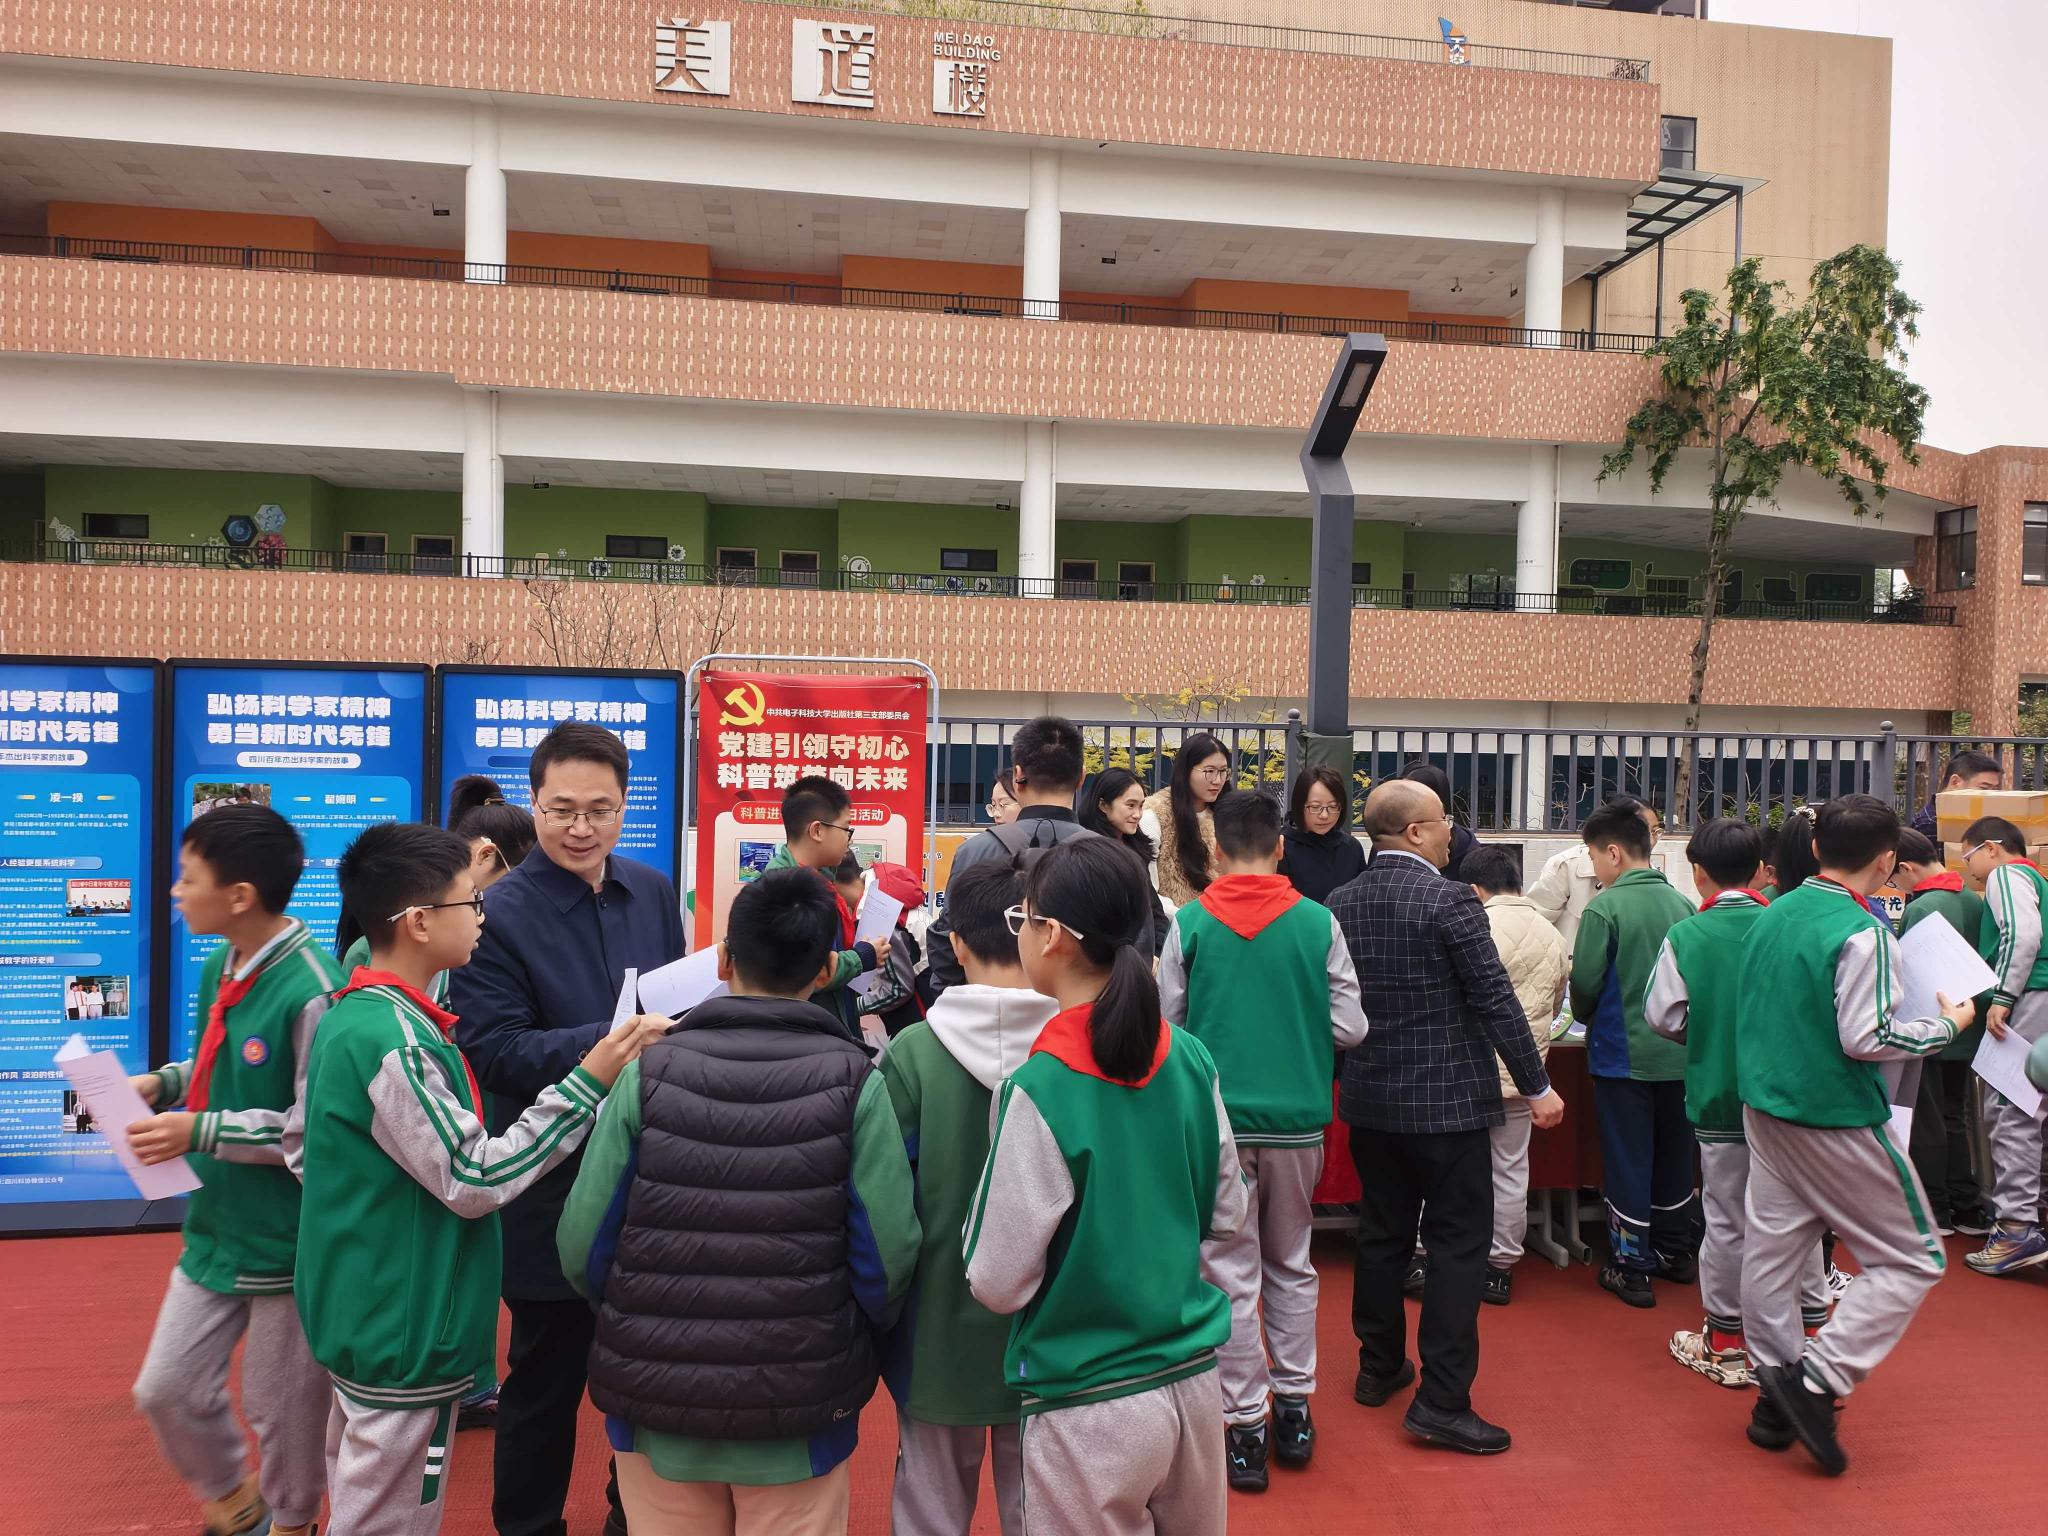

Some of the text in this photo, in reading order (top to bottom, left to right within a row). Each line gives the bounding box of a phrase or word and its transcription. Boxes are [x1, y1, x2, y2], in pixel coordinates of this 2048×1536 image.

[934, 31, 994, 47] MEI DAO
[933, 43, 1001, 61] BUILDING
[207, 693, 391, 718] 弘扬科学家精神
[475, 698, 647, 723] 弘扬科学家精神
[766, 707, 910, 721] 中共电子科技大学出版社第三支部委员会
[207, 722, 391, 747] 勇当新时代先锋
[718, 731, 910, 761] 党建引领守初心
[248, 755, 349, 765] 四川百年杰出科学家的故事
[0, 1071, 18, 1080] 作风
